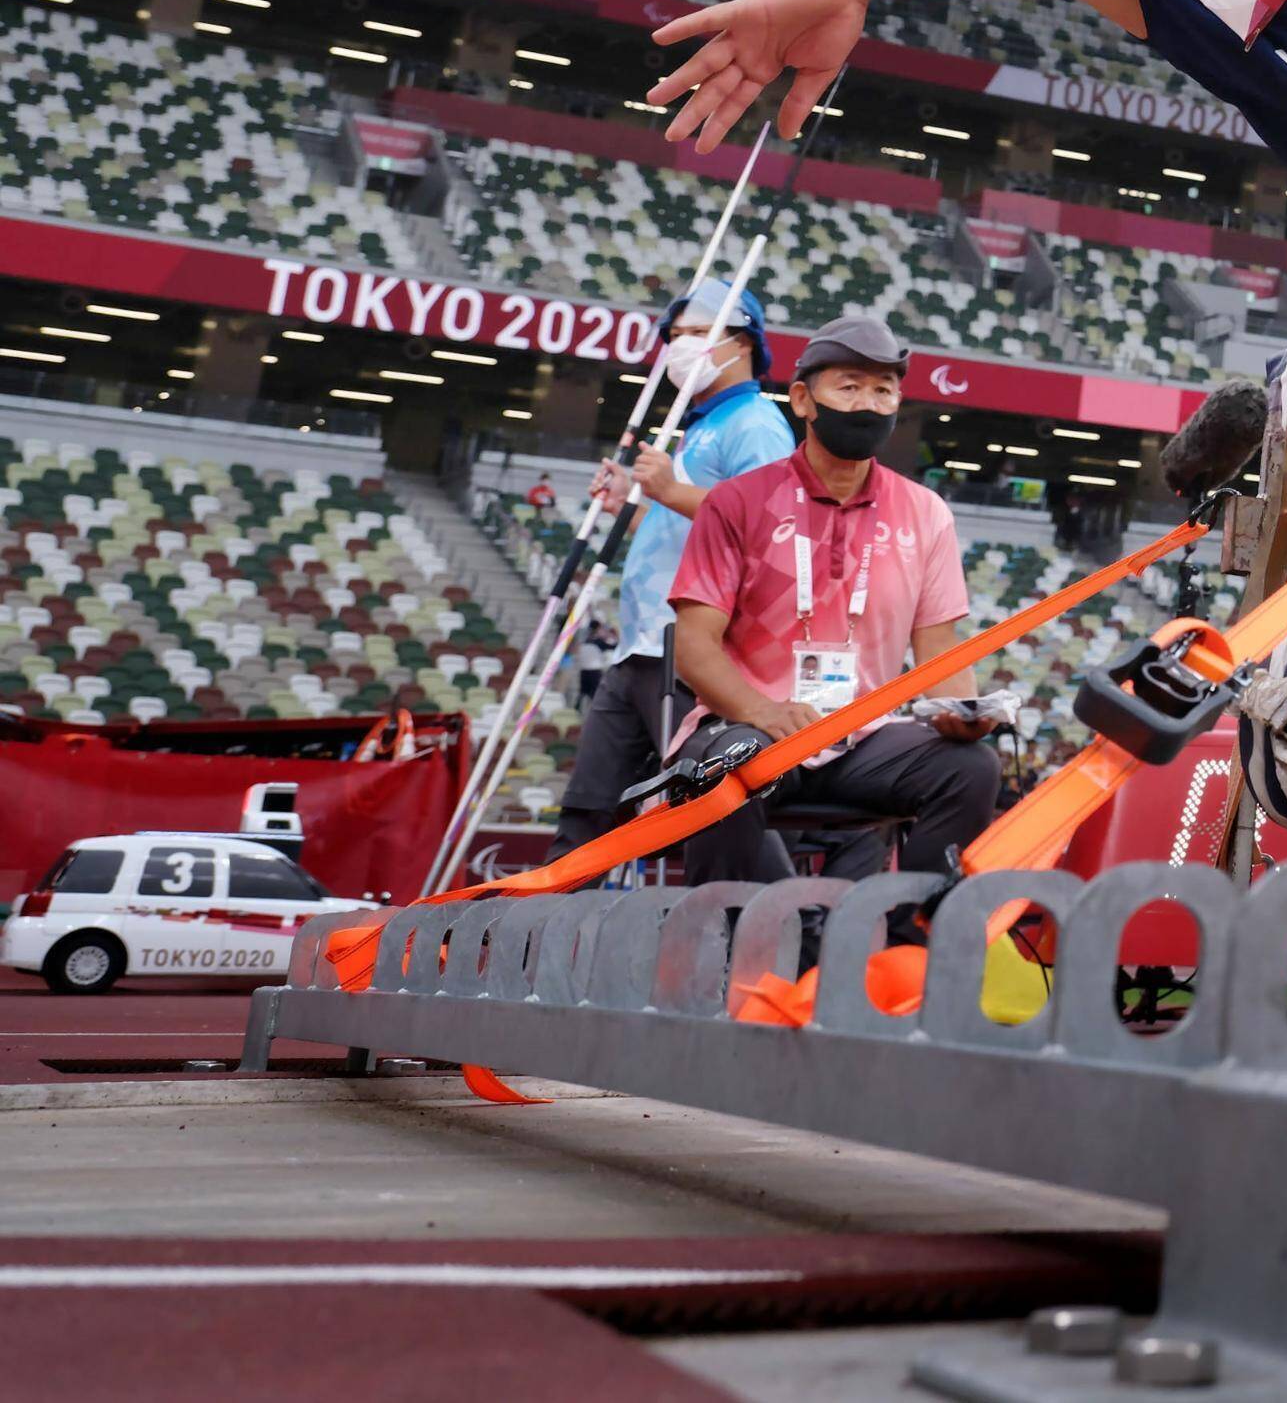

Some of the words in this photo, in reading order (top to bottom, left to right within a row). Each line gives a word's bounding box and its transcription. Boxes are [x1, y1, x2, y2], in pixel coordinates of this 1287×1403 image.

[1043, 72, 1157, 125] TOKYO
[1166, 98, 1248, 142] 2020
[264, 258, 485, 342] TOKYO
[494, 294, 653, 364] 2020
[161, 851, 196, 894] 3
[141, 948, 216, 968] TOKYO
[219, 949, 276, 968] 2020
